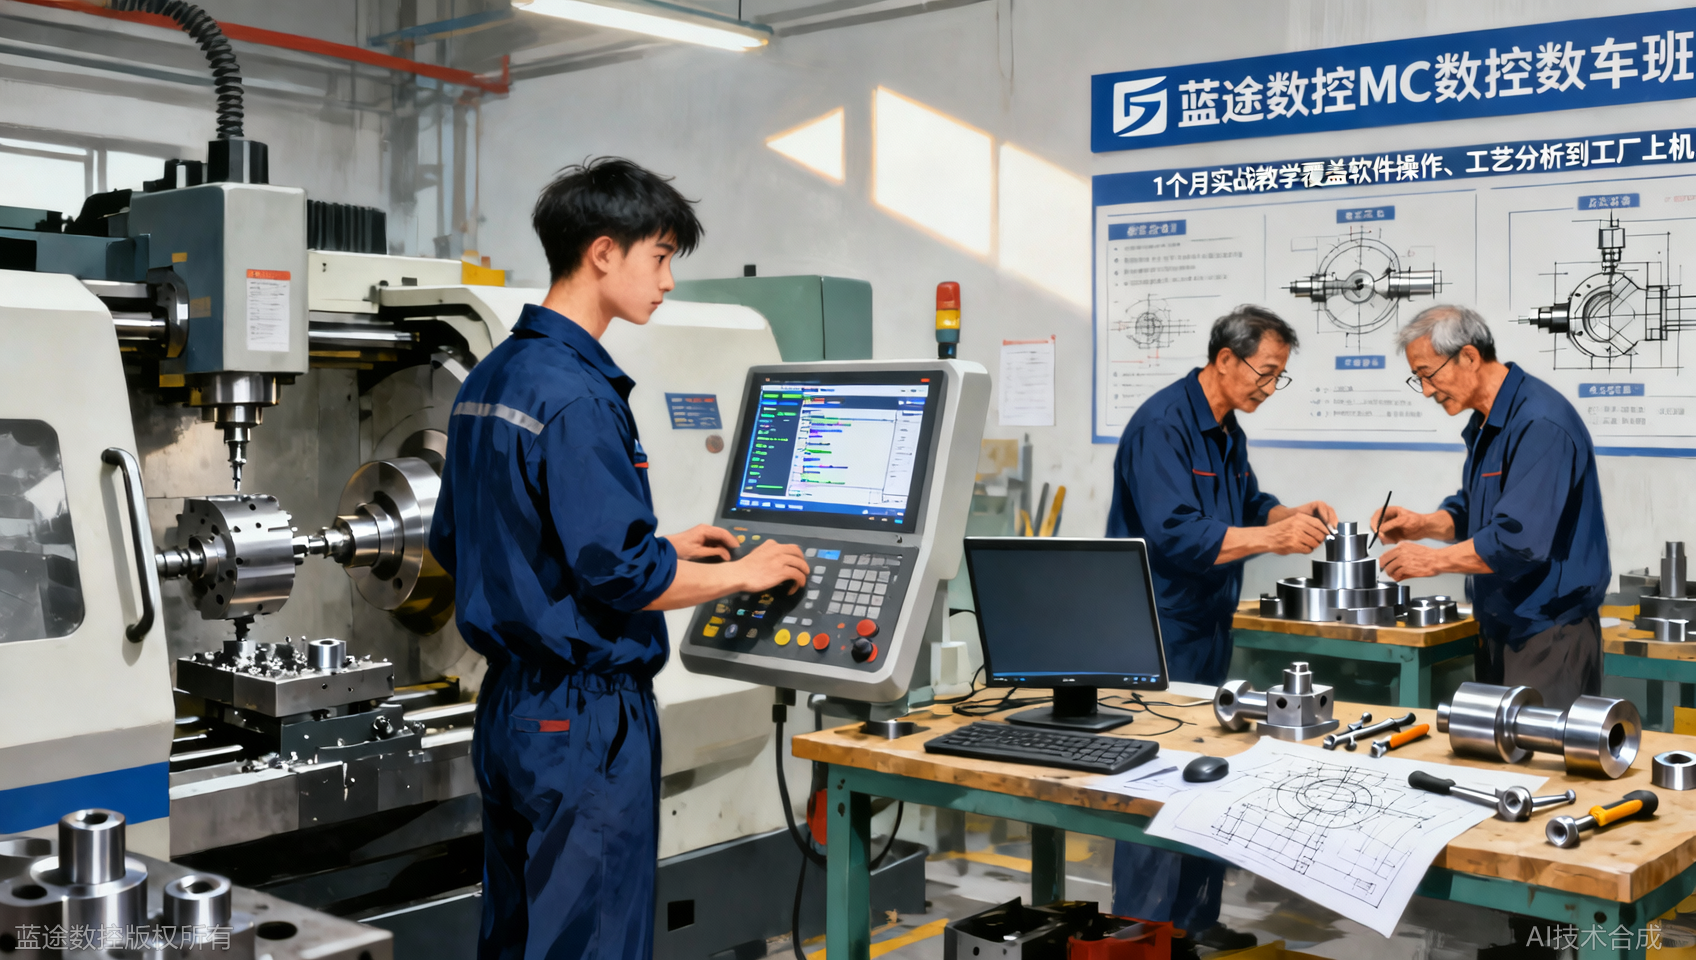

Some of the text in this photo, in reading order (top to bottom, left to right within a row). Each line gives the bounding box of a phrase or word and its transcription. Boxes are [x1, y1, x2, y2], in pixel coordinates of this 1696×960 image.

[1178, 30, 1694, 127] 蓝途数控MC数控数车班
